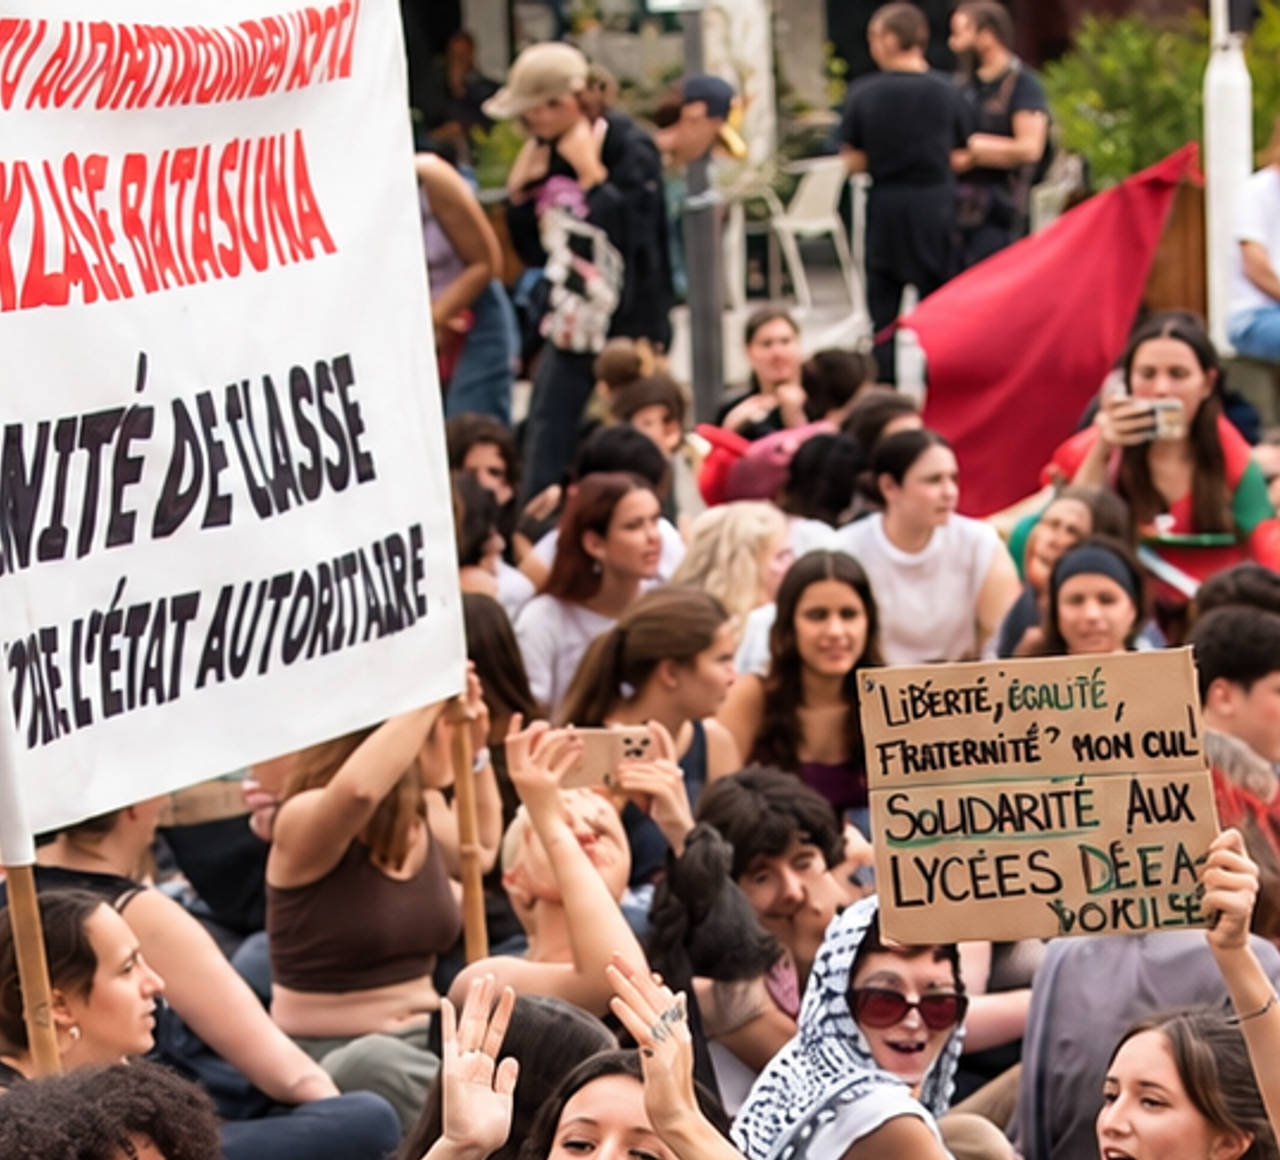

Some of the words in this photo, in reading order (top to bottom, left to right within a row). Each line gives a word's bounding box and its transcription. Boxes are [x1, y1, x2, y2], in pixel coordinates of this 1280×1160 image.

[121, 129, 338, 294] BATASUNA
[151, 390, 233, 540] DE
[71, 576, 201, 730] L'ÉTAT
[194, 523, 428, 690] AUTORITAIRE
[1072, 732, 1135, 763] MON
[1127, 778, 1197, 834] AUX
[890, 849, 1063, 907] LYCÉES
